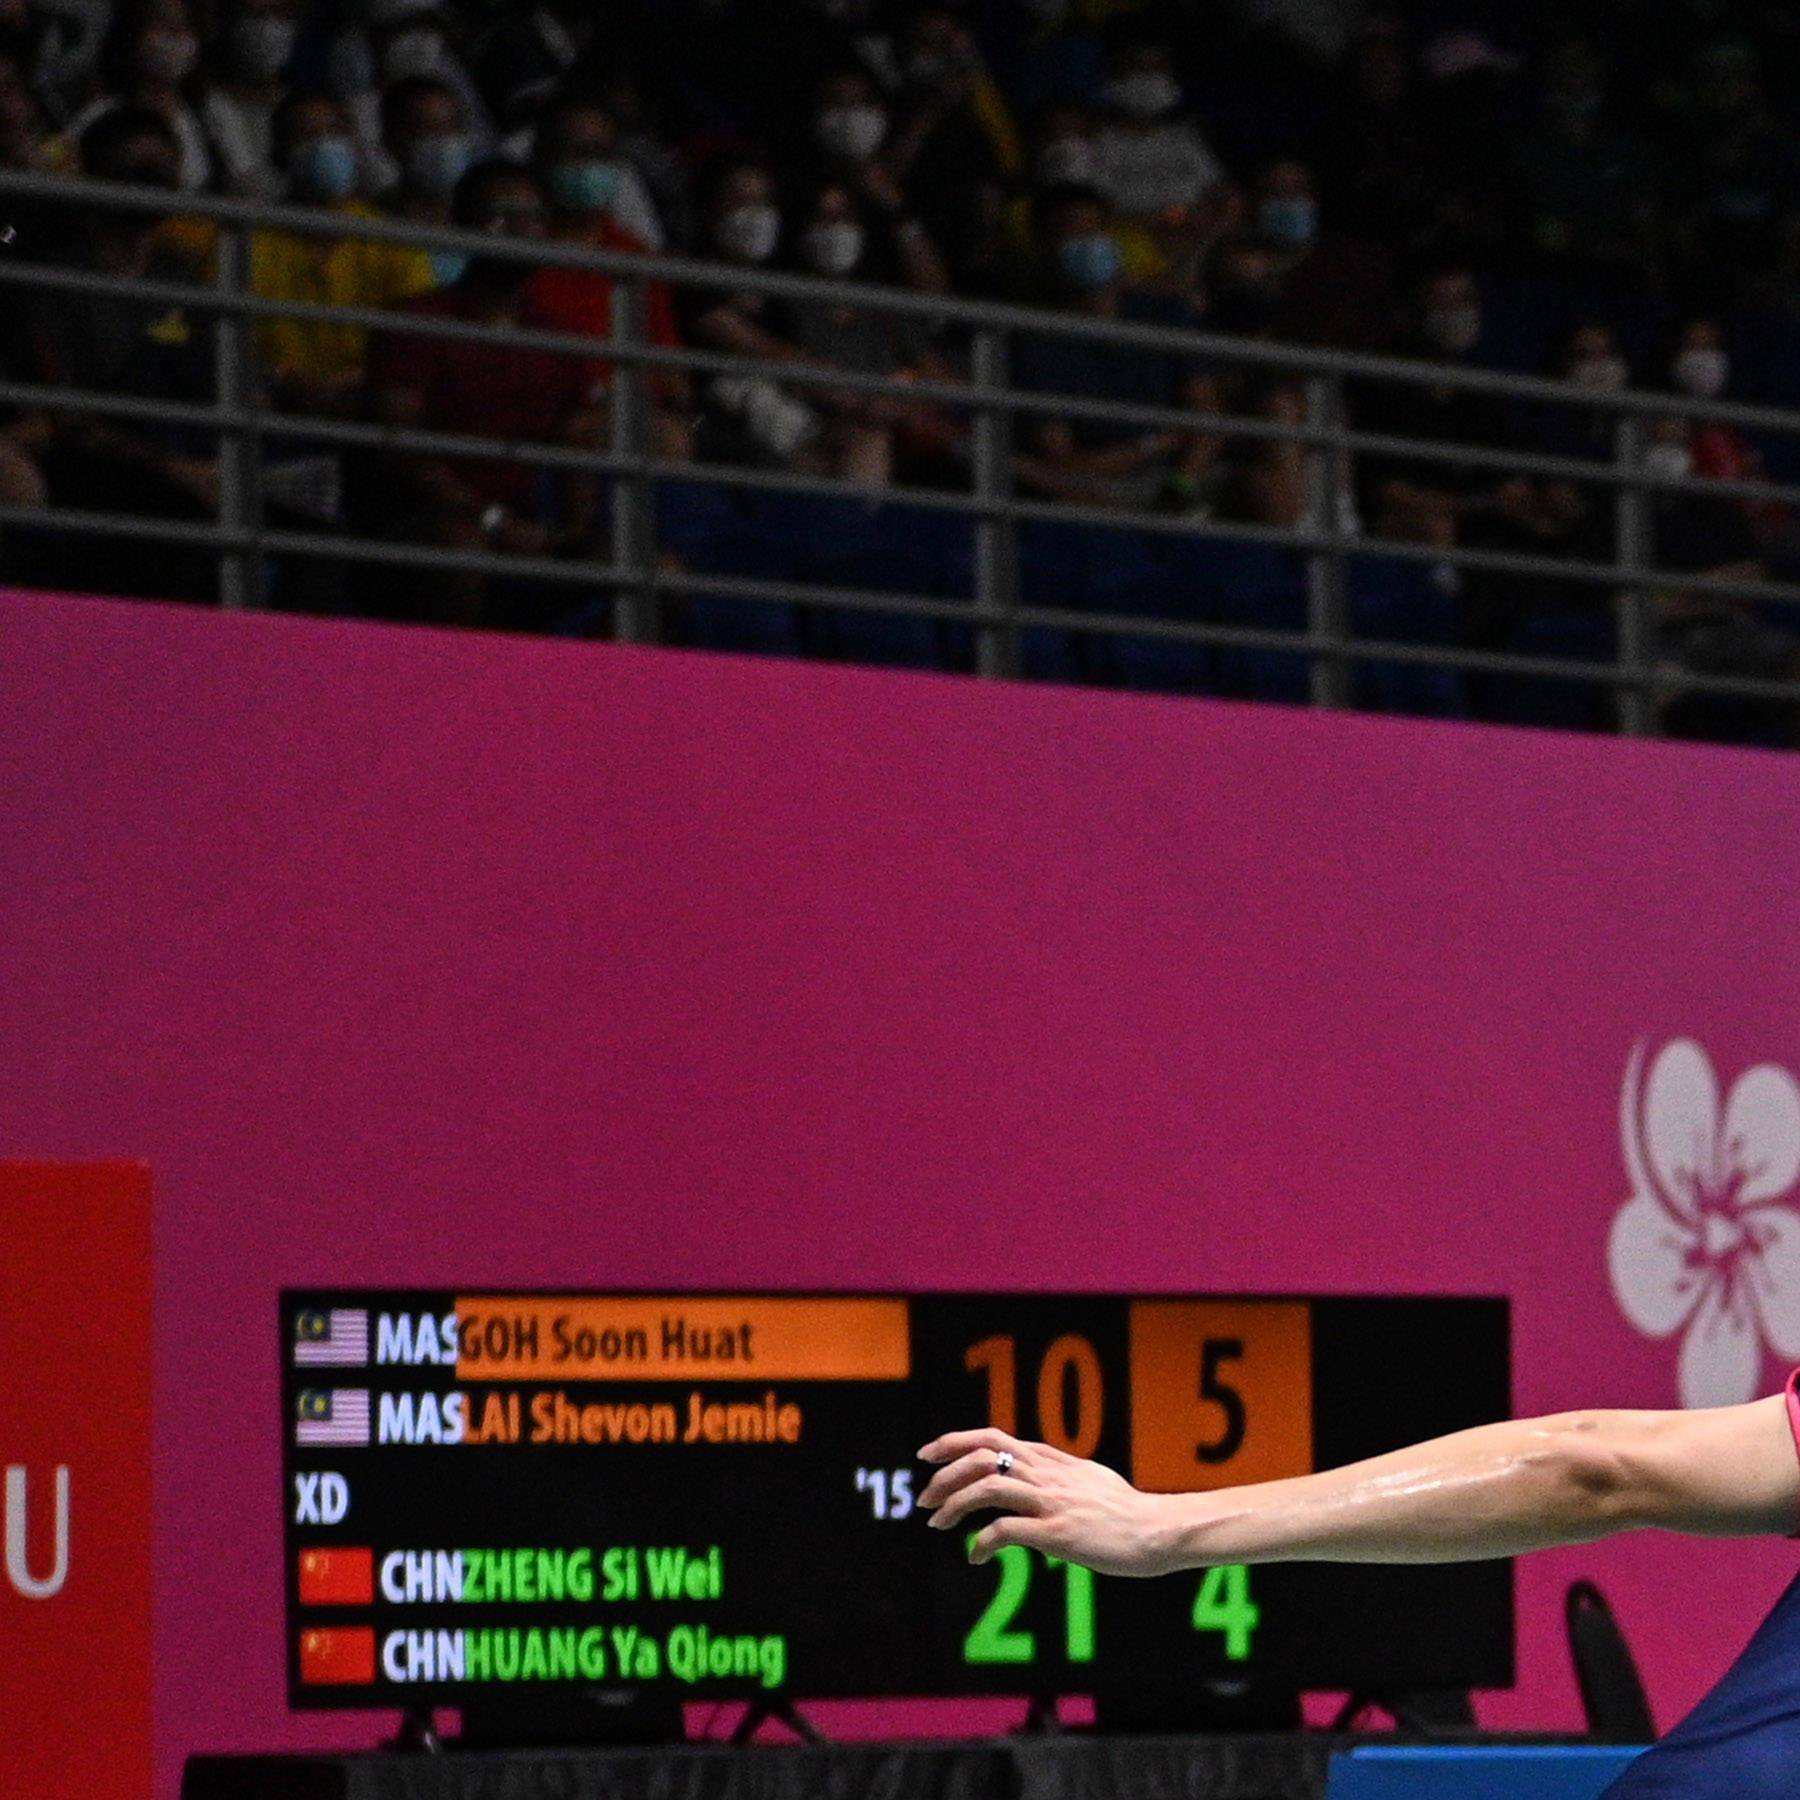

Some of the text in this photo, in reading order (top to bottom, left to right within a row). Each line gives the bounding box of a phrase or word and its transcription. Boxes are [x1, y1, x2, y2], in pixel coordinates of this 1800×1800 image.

[376, 1312, 1249, 1464] MAS GOH Soon Huat 10 5
[378, 1391, 801, 1445] MAS LAI Shevon Jemie
[4, 1464, 71, 1599] U
[294, 1472, 350, 1525] XD
[381, 1549, 463, 1603] CHN
[462, 1547, 595, 1603] ZHENG
[646, 1544, 723, 1600] Wei
[963, 1532, 1096, 1664] 21
[1191, 1562, 1260, 1661] 4
[382, 1623, 787, 1690] CHN HUANG Ya Qiong
